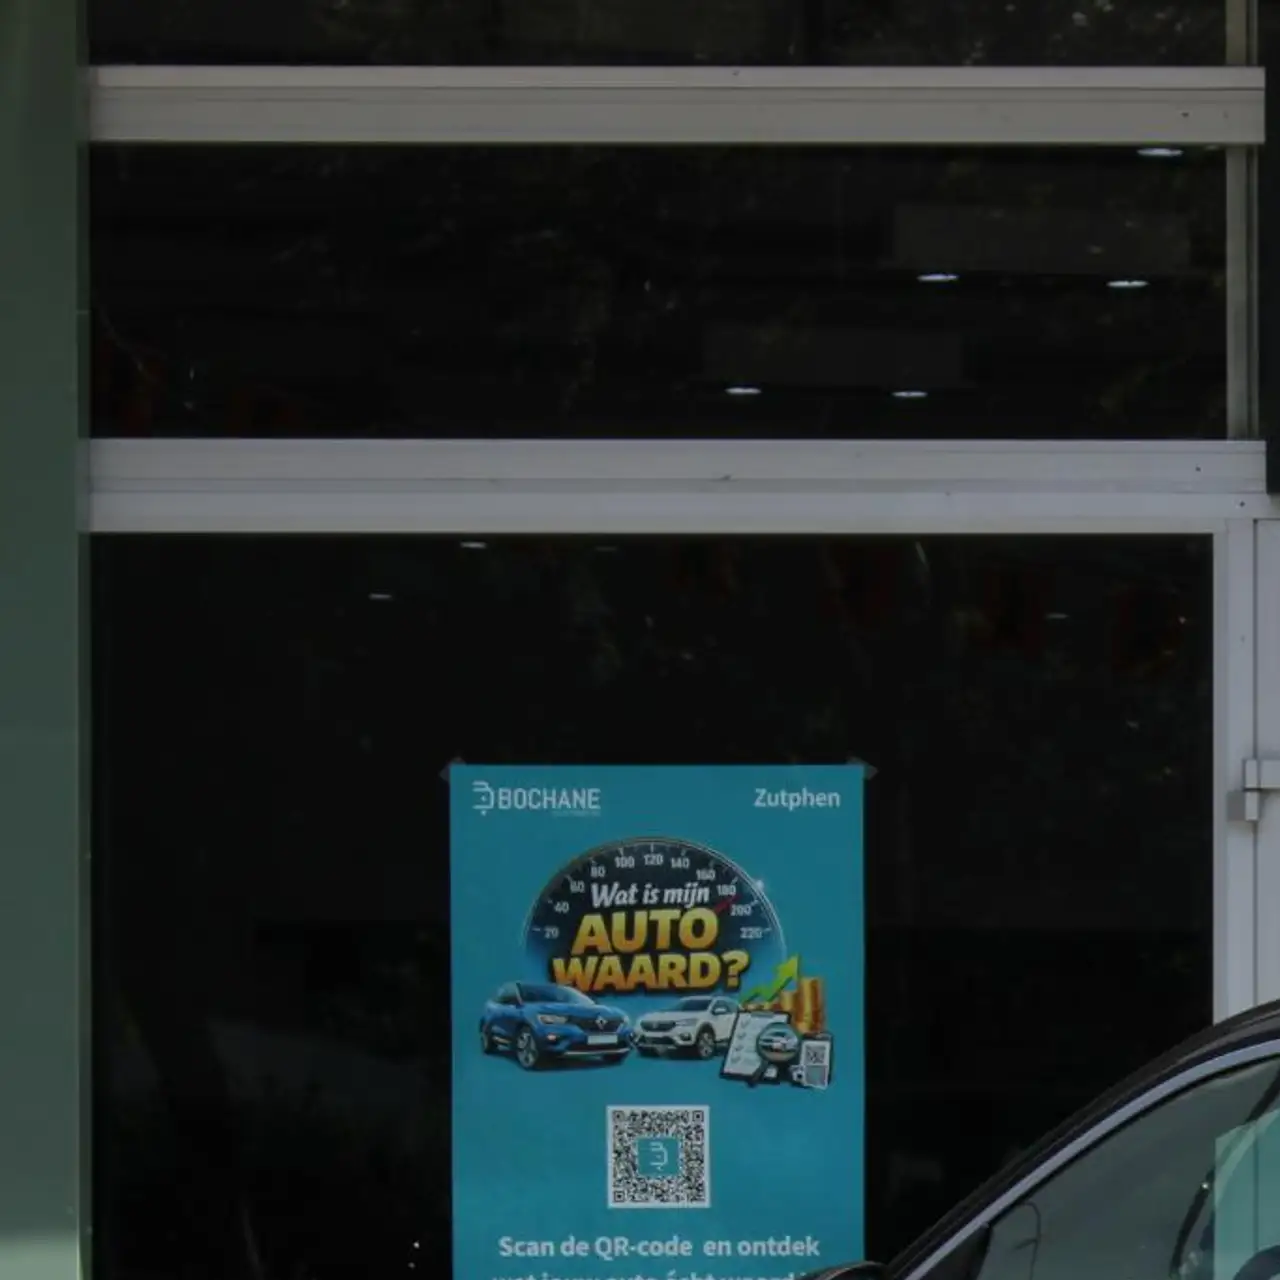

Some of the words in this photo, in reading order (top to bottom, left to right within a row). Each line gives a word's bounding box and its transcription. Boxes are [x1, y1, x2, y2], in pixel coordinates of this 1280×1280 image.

[498, 787, 601, 810] BOCHANE
[753, 787, 841, 812] Zutphen
[554, 901, 570, 914] 40
[615, 856, 635, 869] 100
[643, 853, 664, 866] 120
[671, 856, 690, 869] 140
[590, 881, 639, 908] Wat
[643, 881, 659, 904] is
[663, 882, 711, 909] mijn
[570, 907, 719, 955] AUTO
[552, 950, 749, 992] WAARD?
[498, 1236, 555, 1257] Scan
[559, 1233, 590, 1257] de
[594, 1234, 693, 1261] QR-code
[703, 1239, 732, 1257] en
[737, 1235, 820, 1257] ontdek
